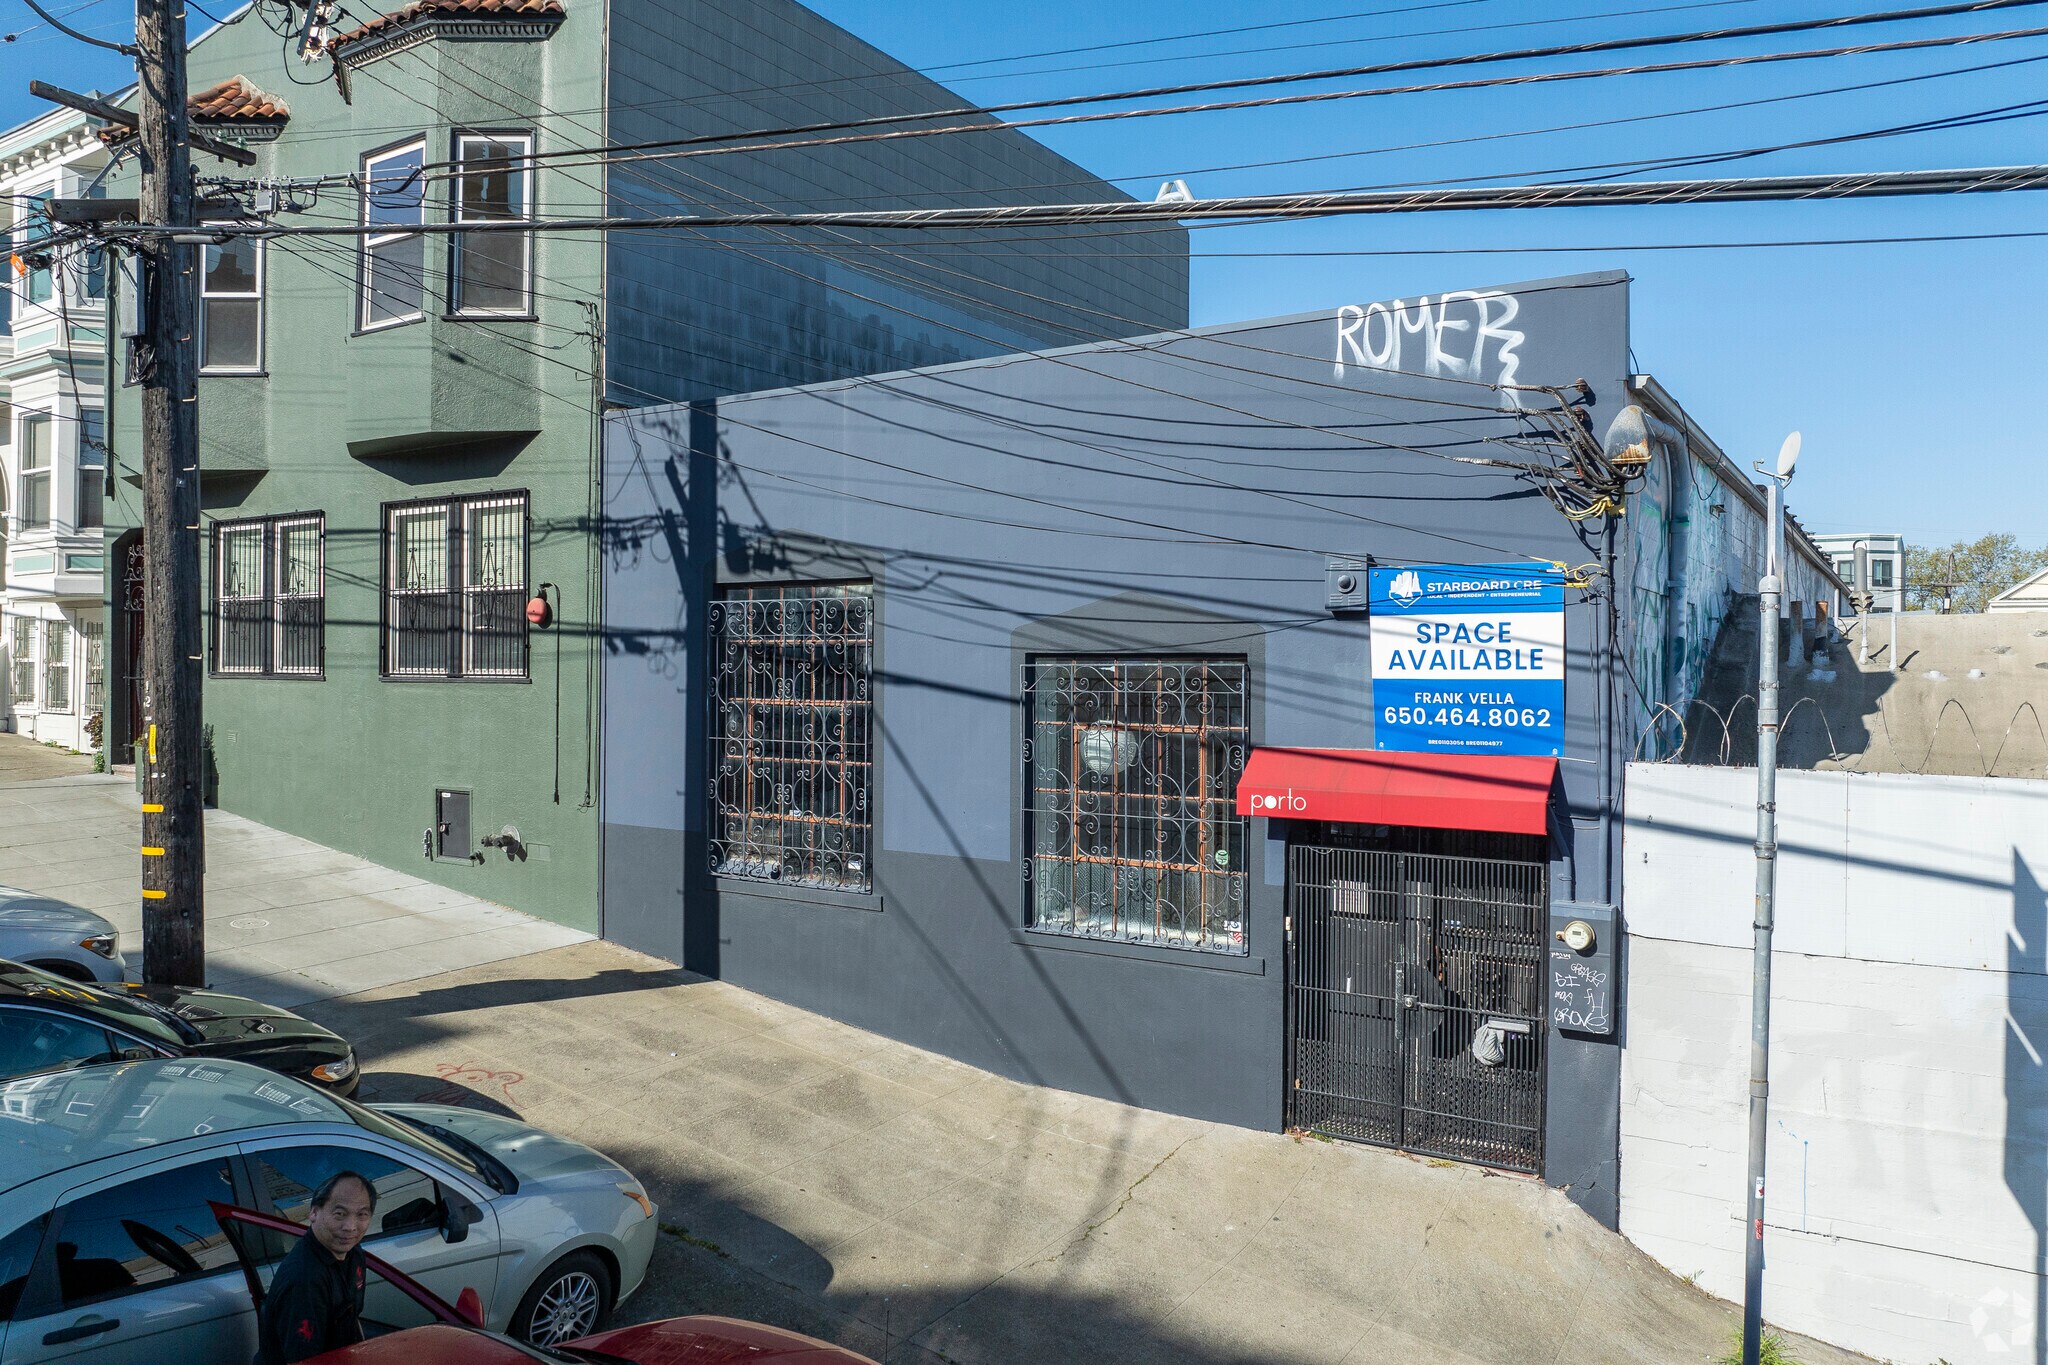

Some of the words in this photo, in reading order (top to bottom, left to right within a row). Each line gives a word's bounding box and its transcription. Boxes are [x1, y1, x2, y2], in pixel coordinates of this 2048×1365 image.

[1427, 580, 1510, 592] STARBOARD
[1513, 579, 1542, 590] CRE
[1416, 621, 1512, 644] SPACE
[1388, 648, 1544, 670] AVAILABLE
[1414, 692, 1464, 704] FRANK
[1468, 692, 1515, 705] VELLA
[1384, 706, 1551, 727] 650.464.8062
[1251, 788, 1307, 816] porto
